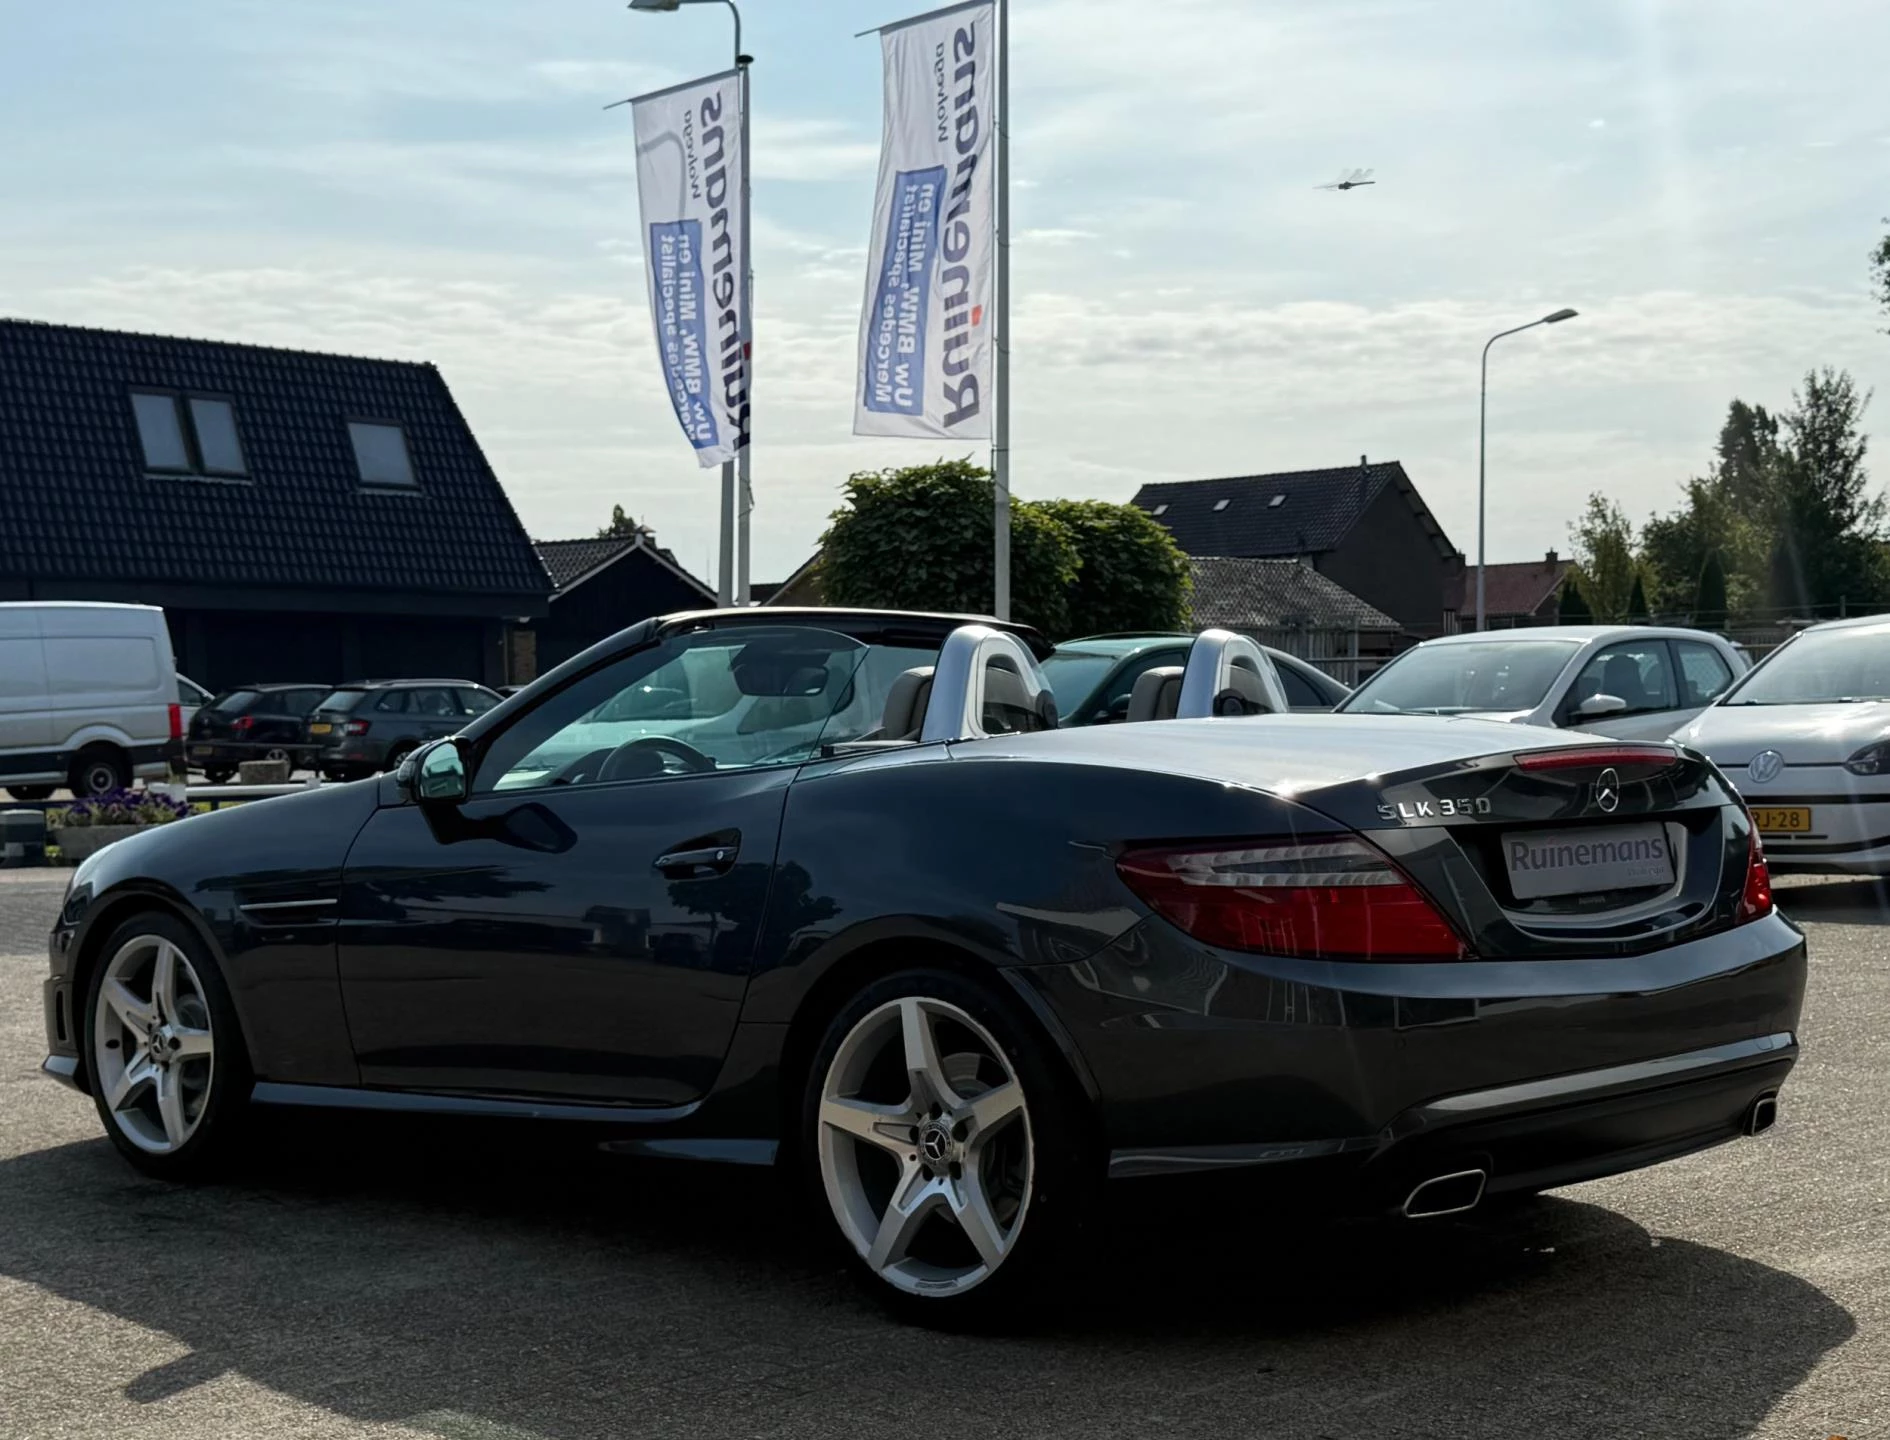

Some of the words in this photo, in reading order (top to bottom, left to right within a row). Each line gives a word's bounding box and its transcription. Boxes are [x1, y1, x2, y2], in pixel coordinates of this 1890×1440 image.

[1376, 801, 1435, 821] SLK
[1439, 797, 1491, 816] 350
[1510, 836, 1664, 872] Ruinemans
